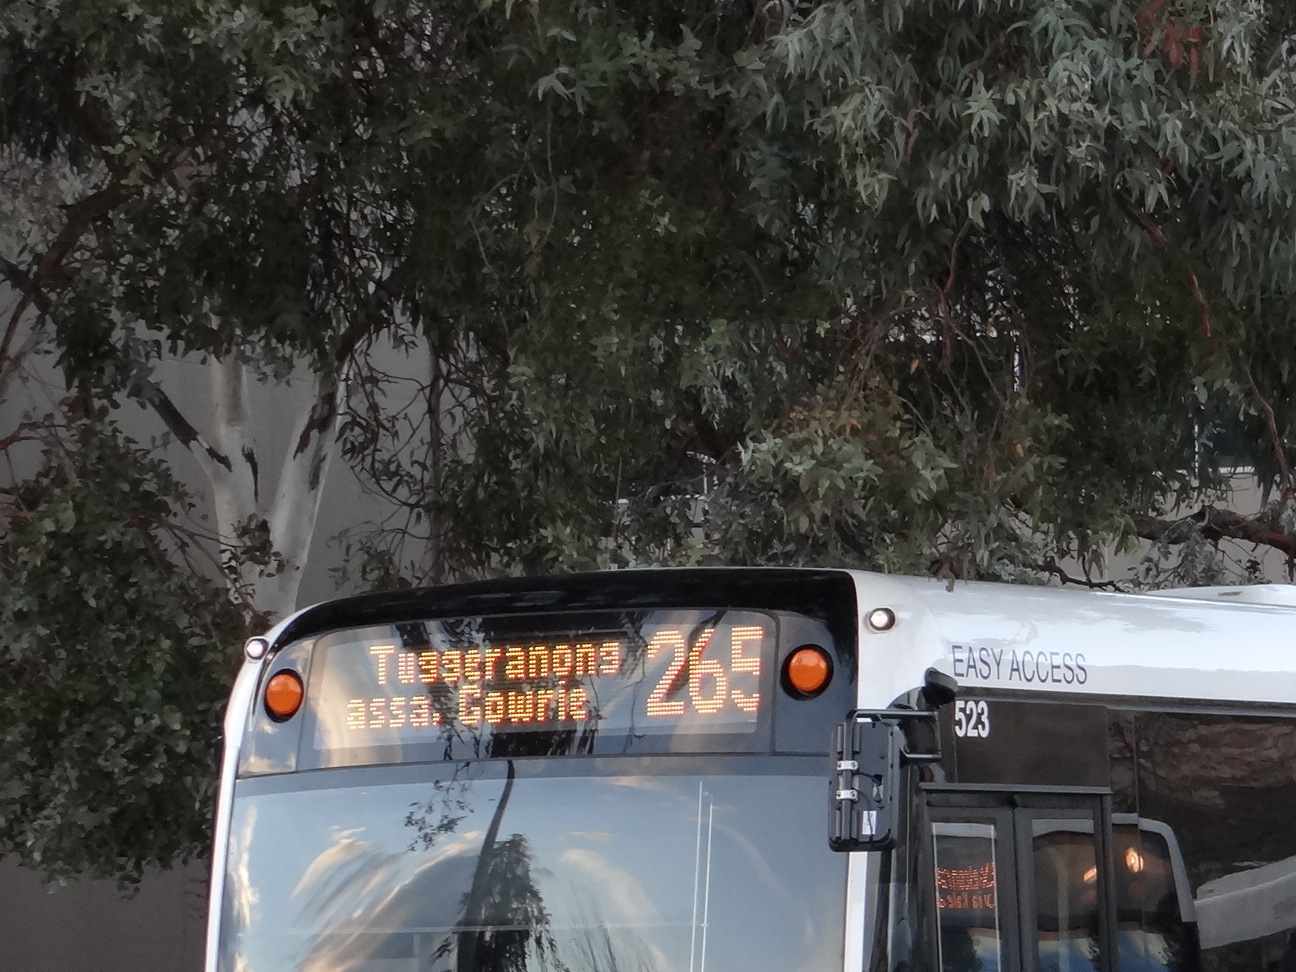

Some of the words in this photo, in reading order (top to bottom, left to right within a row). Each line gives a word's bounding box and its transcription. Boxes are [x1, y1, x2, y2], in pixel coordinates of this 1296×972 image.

[369, 642, 622, 686] Tuggeranong
[646, 626, 763, 716] 265
[951, 644, 1004, 680] EASY
[1008, 649, 1088, 685] ACCESS
[457, 679, 588, 726] Gowrie
[954, 699, 990, 738] 523
